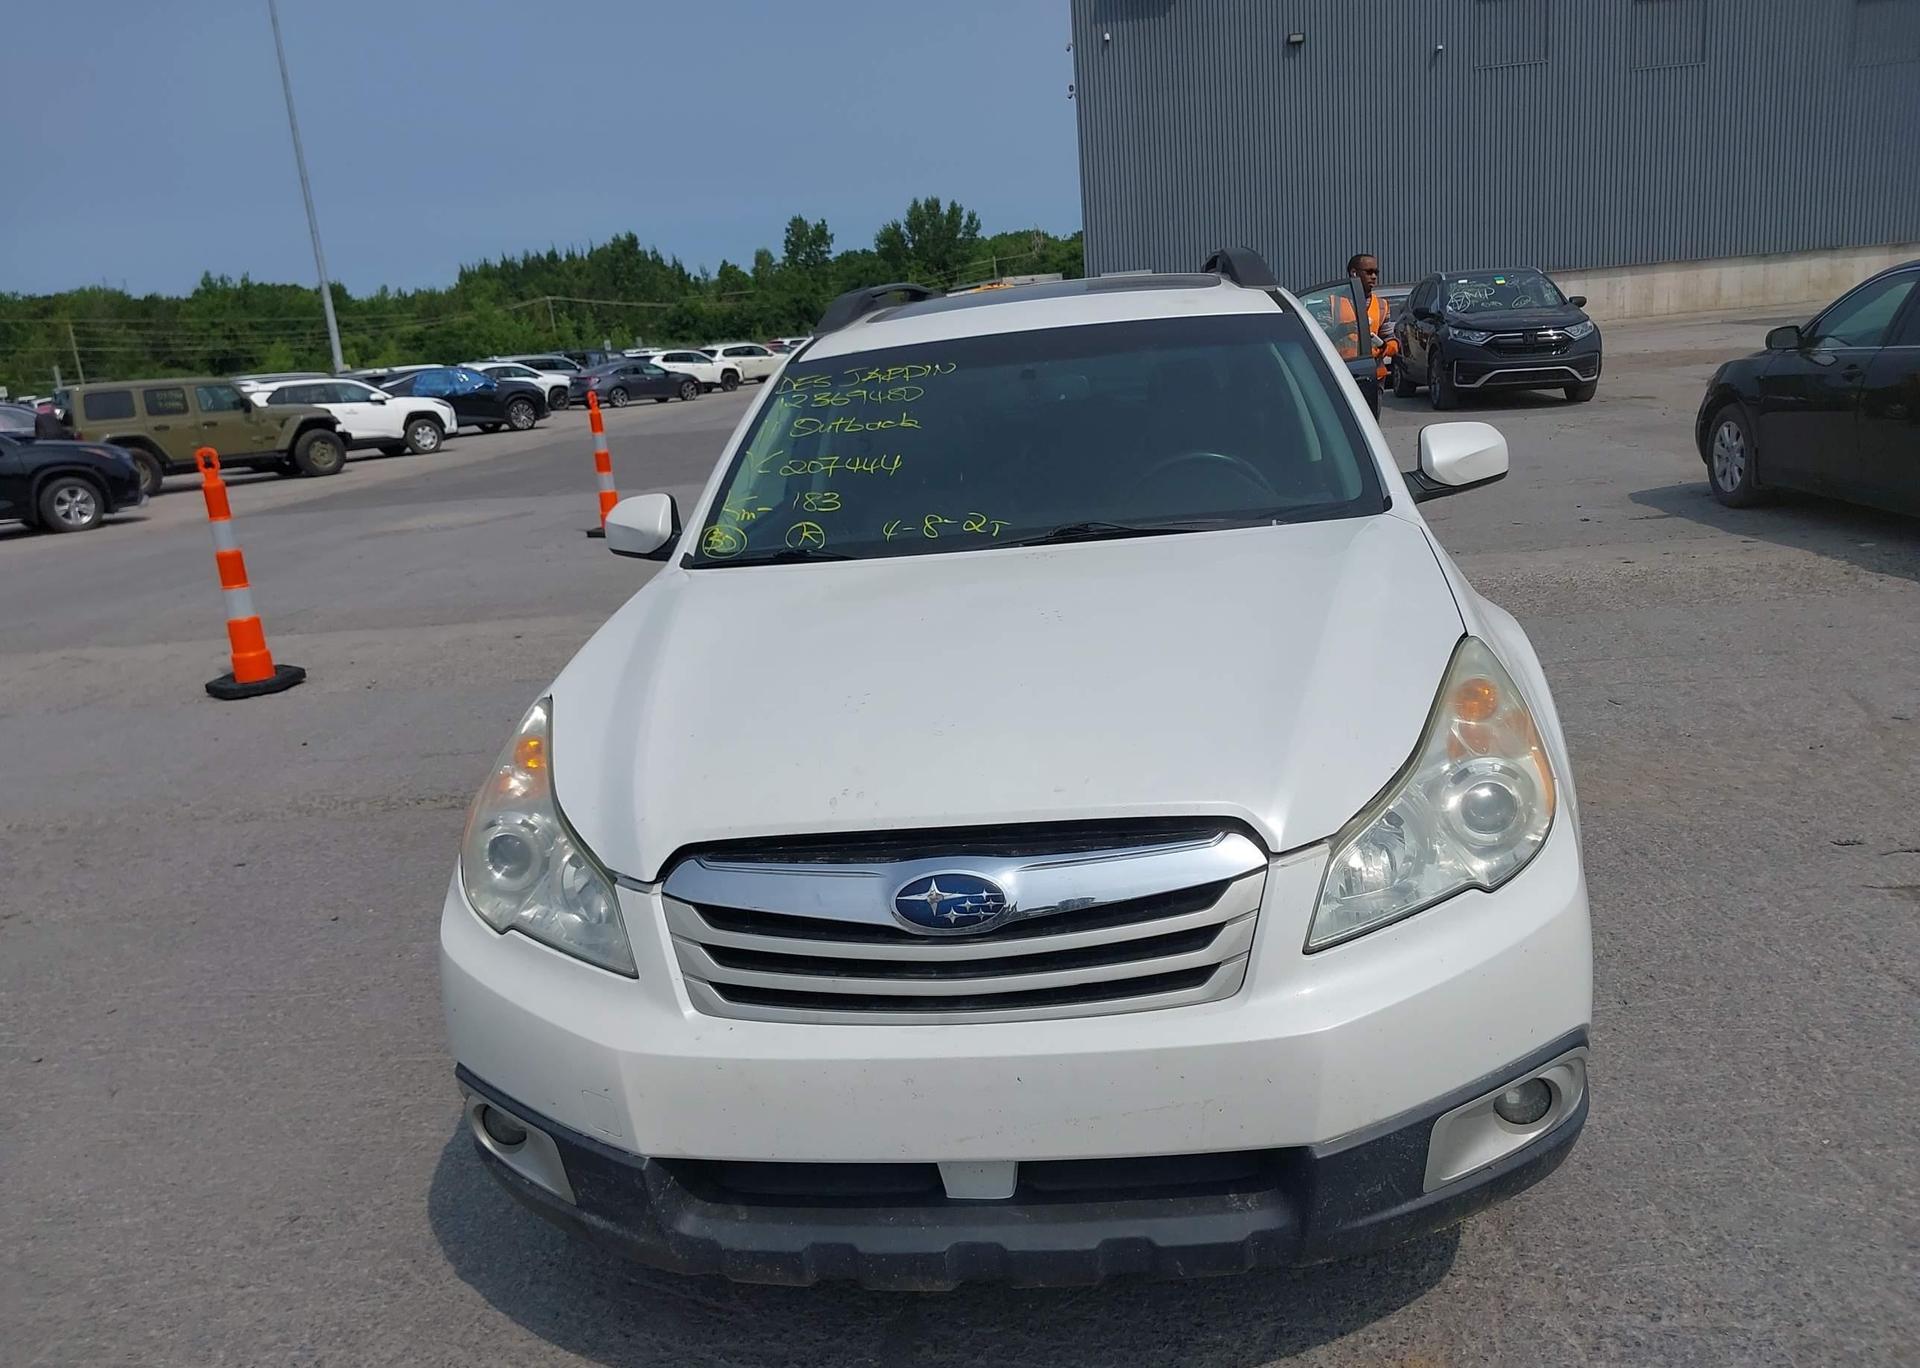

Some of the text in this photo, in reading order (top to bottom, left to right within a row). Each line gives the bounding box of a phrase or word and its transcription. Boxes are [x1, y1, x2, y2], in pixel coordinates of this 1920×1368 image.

[775, 374, 832, 395] DES
[790, 412, 922, 437] Outback
[779, 453, 904, 478] 207444
[792, 491, 842, 512] 183
